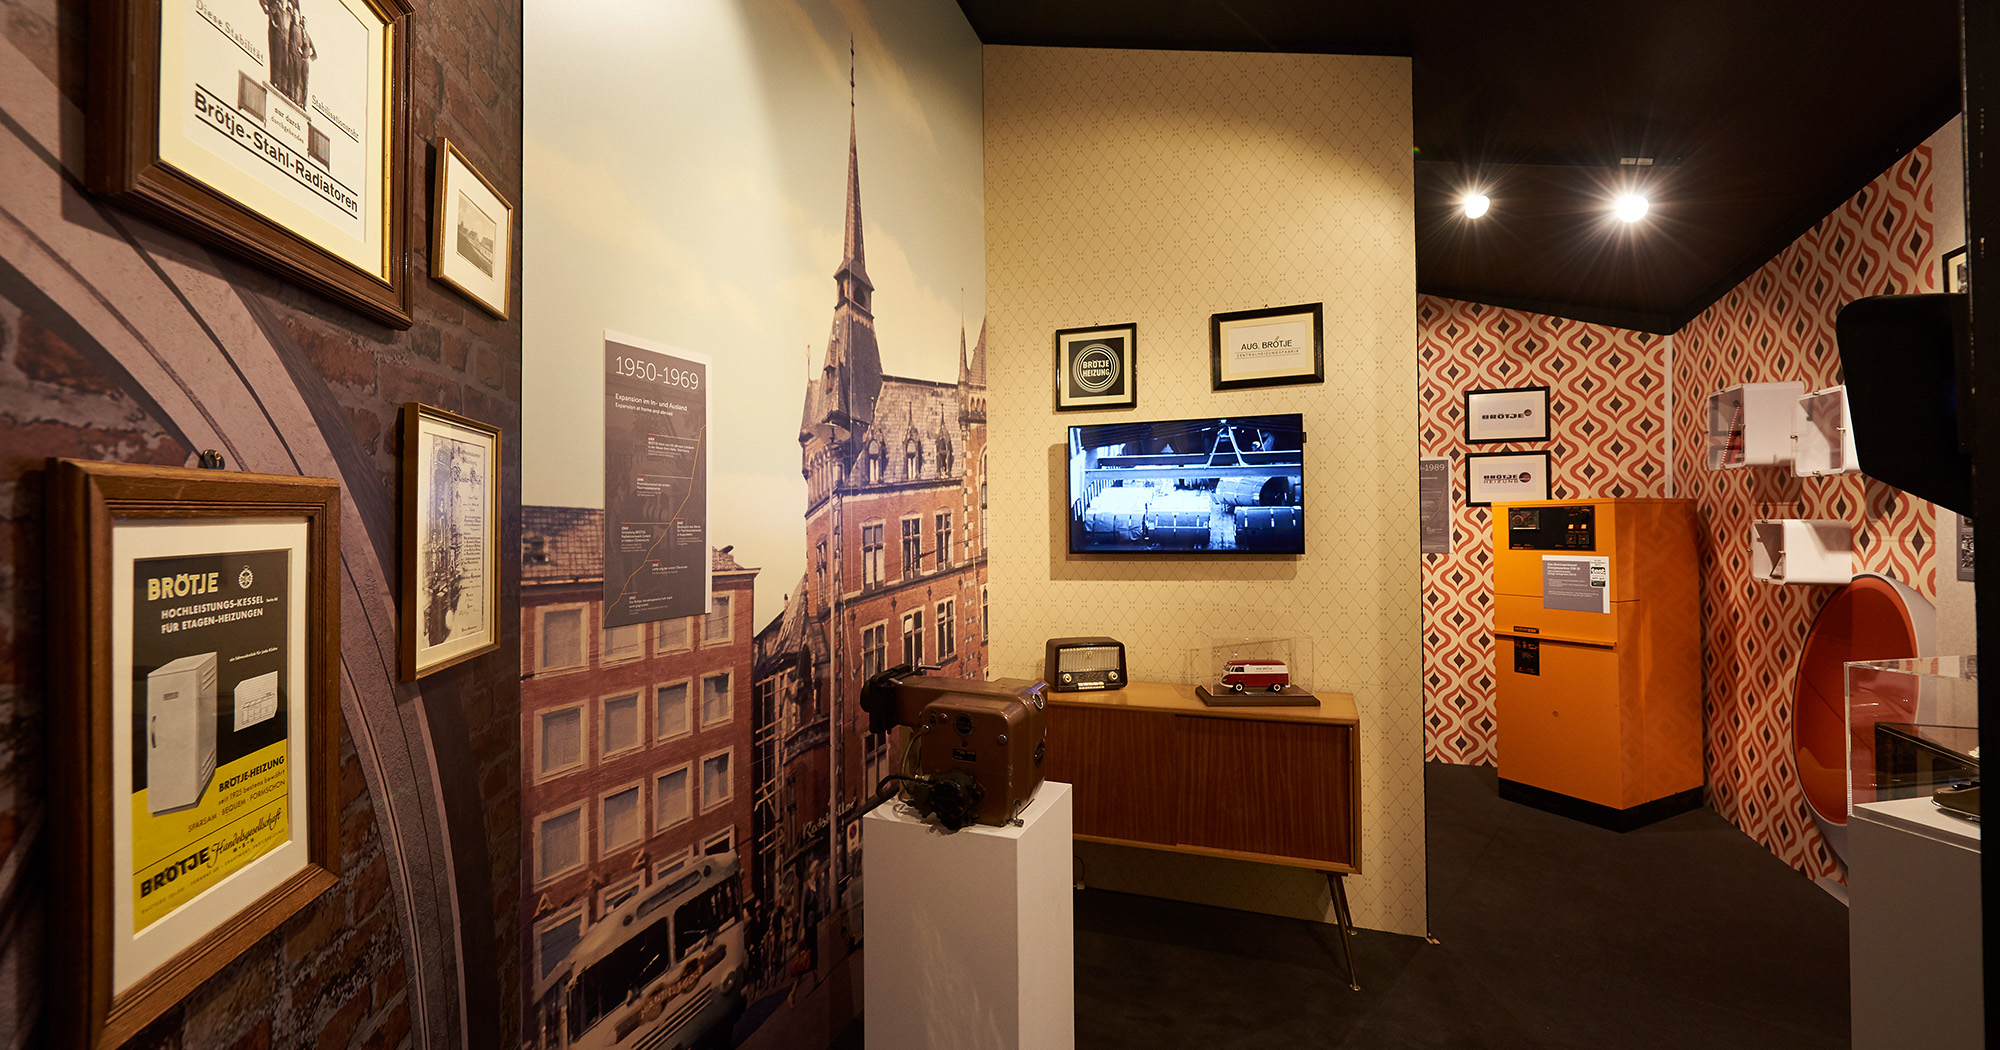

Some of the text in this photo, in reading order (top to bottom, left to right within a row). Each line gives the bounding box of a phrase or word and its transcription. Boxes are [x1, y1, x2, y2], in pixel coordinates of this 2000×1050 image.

[196, 0, 264, 62] Diese Stabilität
[194, 89, 358, 213] Brötje-Stahl-Radiatoren
[1240, 342, 1260, 351] AUG.
[615, 355, 699, 390] 1950-1969
[1082, 368, 1110, 377] HEIZUNG
[615, 393, 642, 405] Expansion
[659, 400, 669, 409] und
[669, 401, 688, 412] Ausland
[615, 402, 636, 412] Expansion
[1420, 463, 1446, 472] -1989
[147, 572, 219, 601] BRÖTJE
[161, 595, 264, 620] HOCHLEISTUNGS-KESSEL
[161, 607, 264, 635] FÜR ETAGEN-HEIZUNGEN
[218, 755, 285, 793] BRÖTJE-HEIZUNG
[229, 788, 243, 800] 1925
[243, 781, 264, 794] bestens
[264, 769, 286, 784] bewährt
[188, 812, 217, 833] SPARSAM
[221, 799, 246, 816] BEQUEM
[140, 845, 211, 899] BRÖTJE
